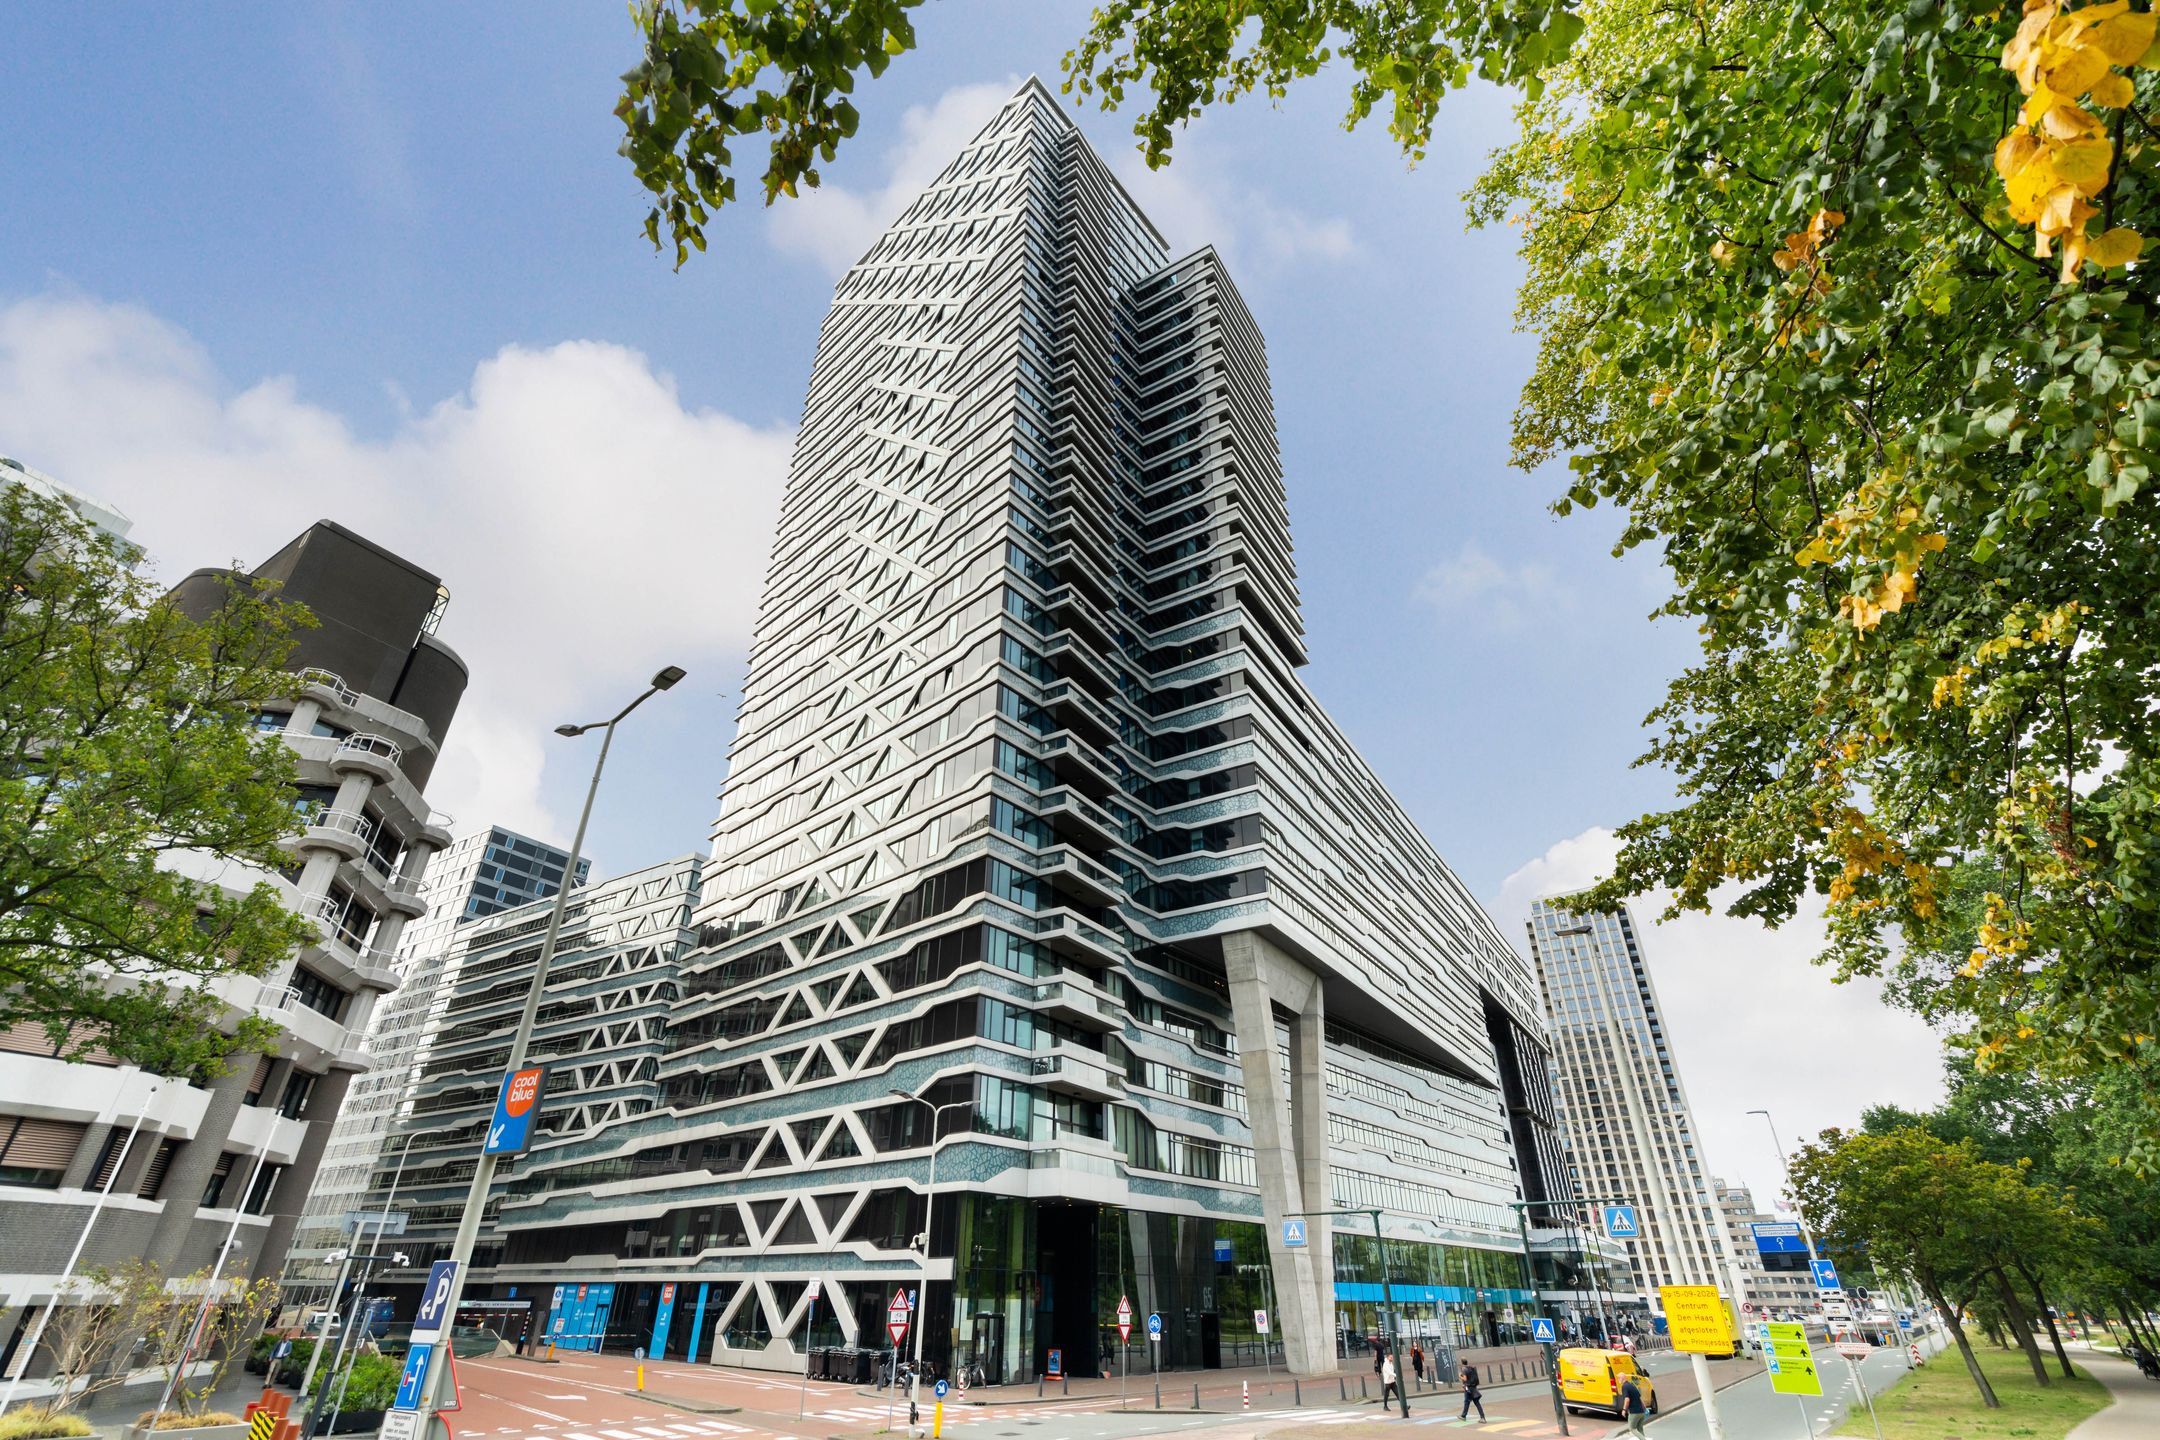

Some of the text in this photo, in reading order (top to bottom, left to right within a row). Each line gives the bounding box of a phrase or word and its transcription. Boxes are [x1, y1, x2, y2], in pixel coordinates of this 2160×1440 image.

[514, 1072, 539, 1088] cool
[510, 1088, 535, 1103] blue
[428, 1277, 450, 1320] P
[1694, 1314, 1714, 1323] Haag
[1679, 1326, 1718, 1335] afgesloten
